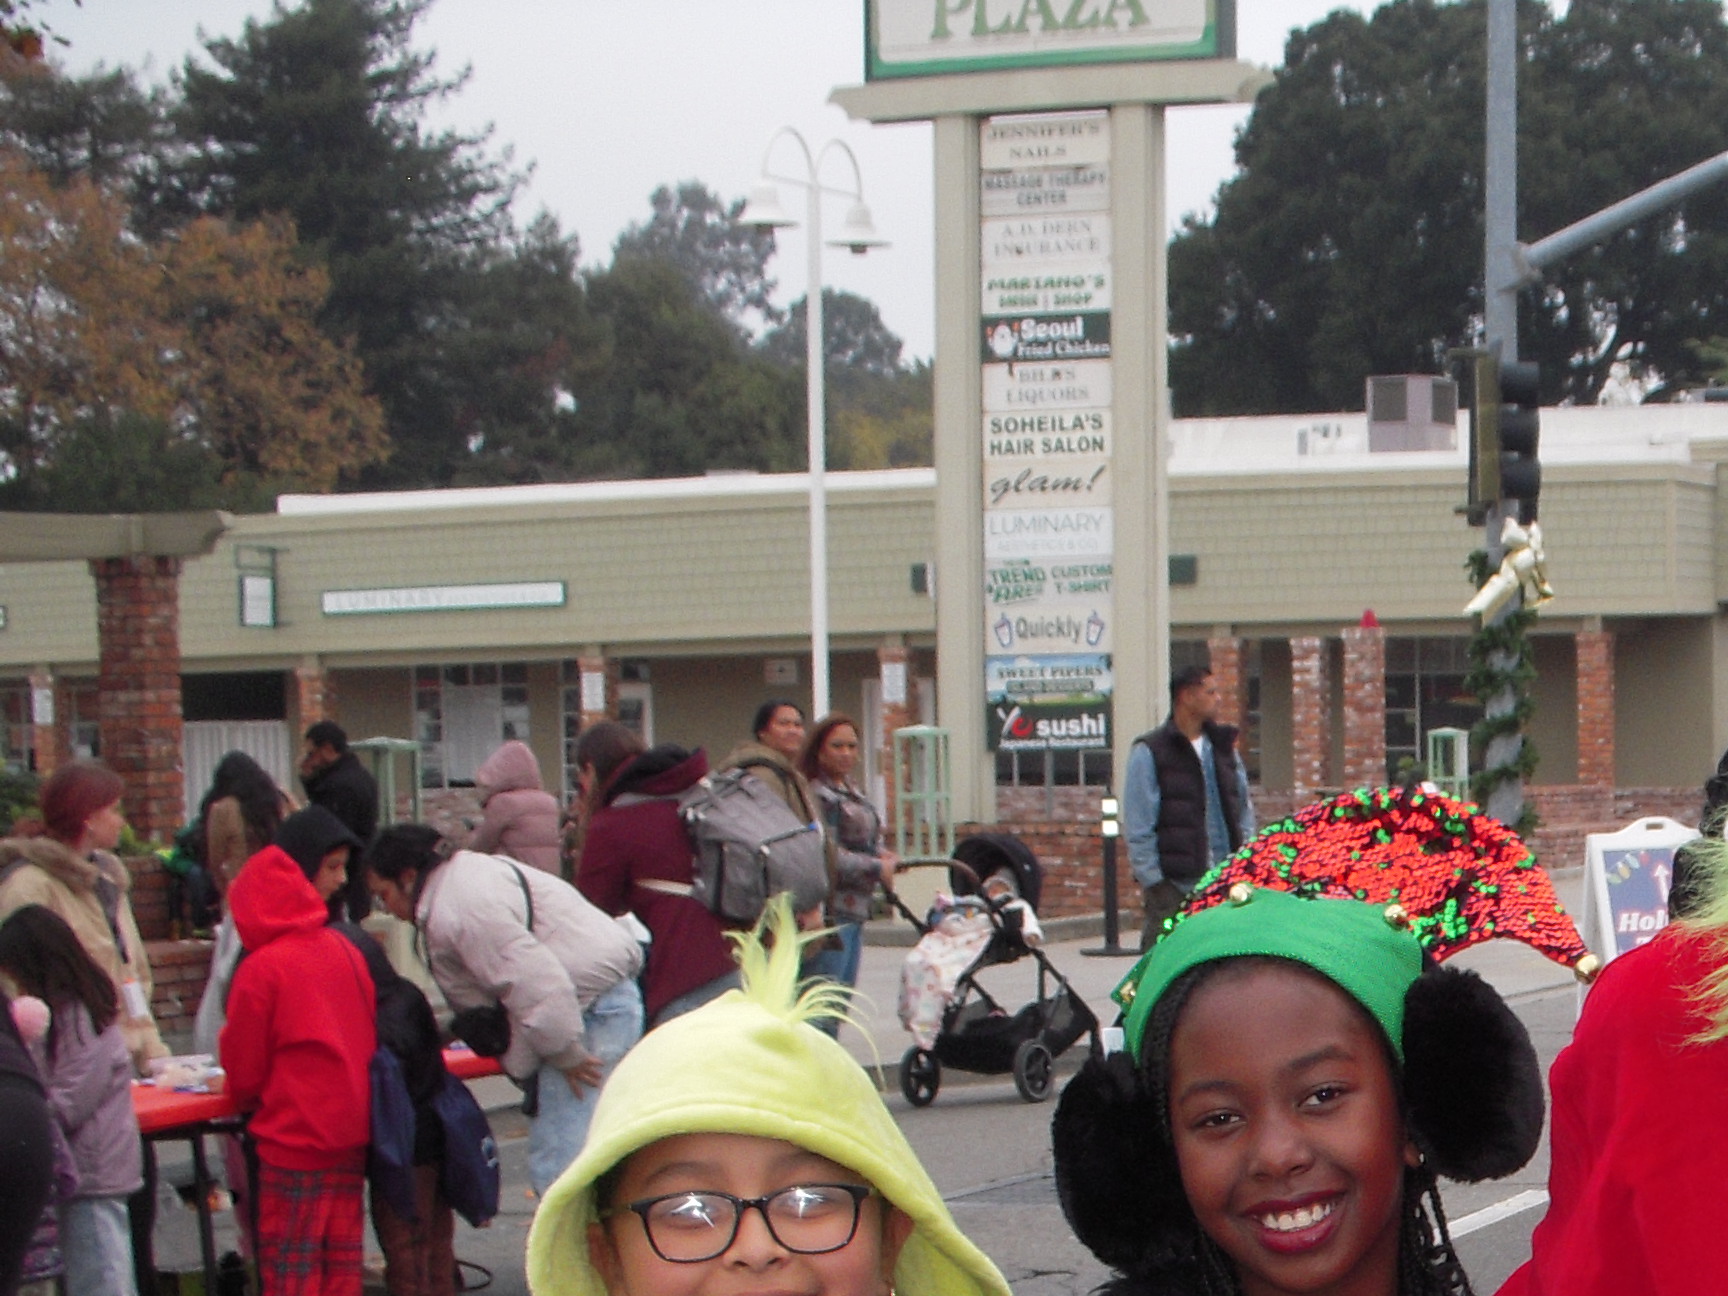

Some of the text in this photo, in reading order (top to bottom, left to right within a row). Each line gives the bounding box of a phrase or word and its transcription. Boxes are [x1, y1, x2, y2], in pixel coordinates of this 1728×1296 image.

[1009, 144, 1067, 158] NAILS
[1047, 169, 1106, 187] THERAPY
[1016, 189, 1067, 205] CENTER
[1020, 316, 1084, 340] Seoul
[1017, 338, 1110, 358] Fried Chicken
[1006, 386, 1090, 404] LIQUORS
[990, 412, 1103, 434] SOHEILA'S
[990, 434, 1104, 457] HAIR SALON
[990, 466, 1106, 502] glam!
[990, 512, 1103, 535] LUMINARY
[988, 564, 1113, 585] TREND CUSTOM
[1054, 579, 1111, 595] T-SHIRT
[1015, 615, 1081, 644] Quickly
[1036, 712, 1107, 738] sushi
